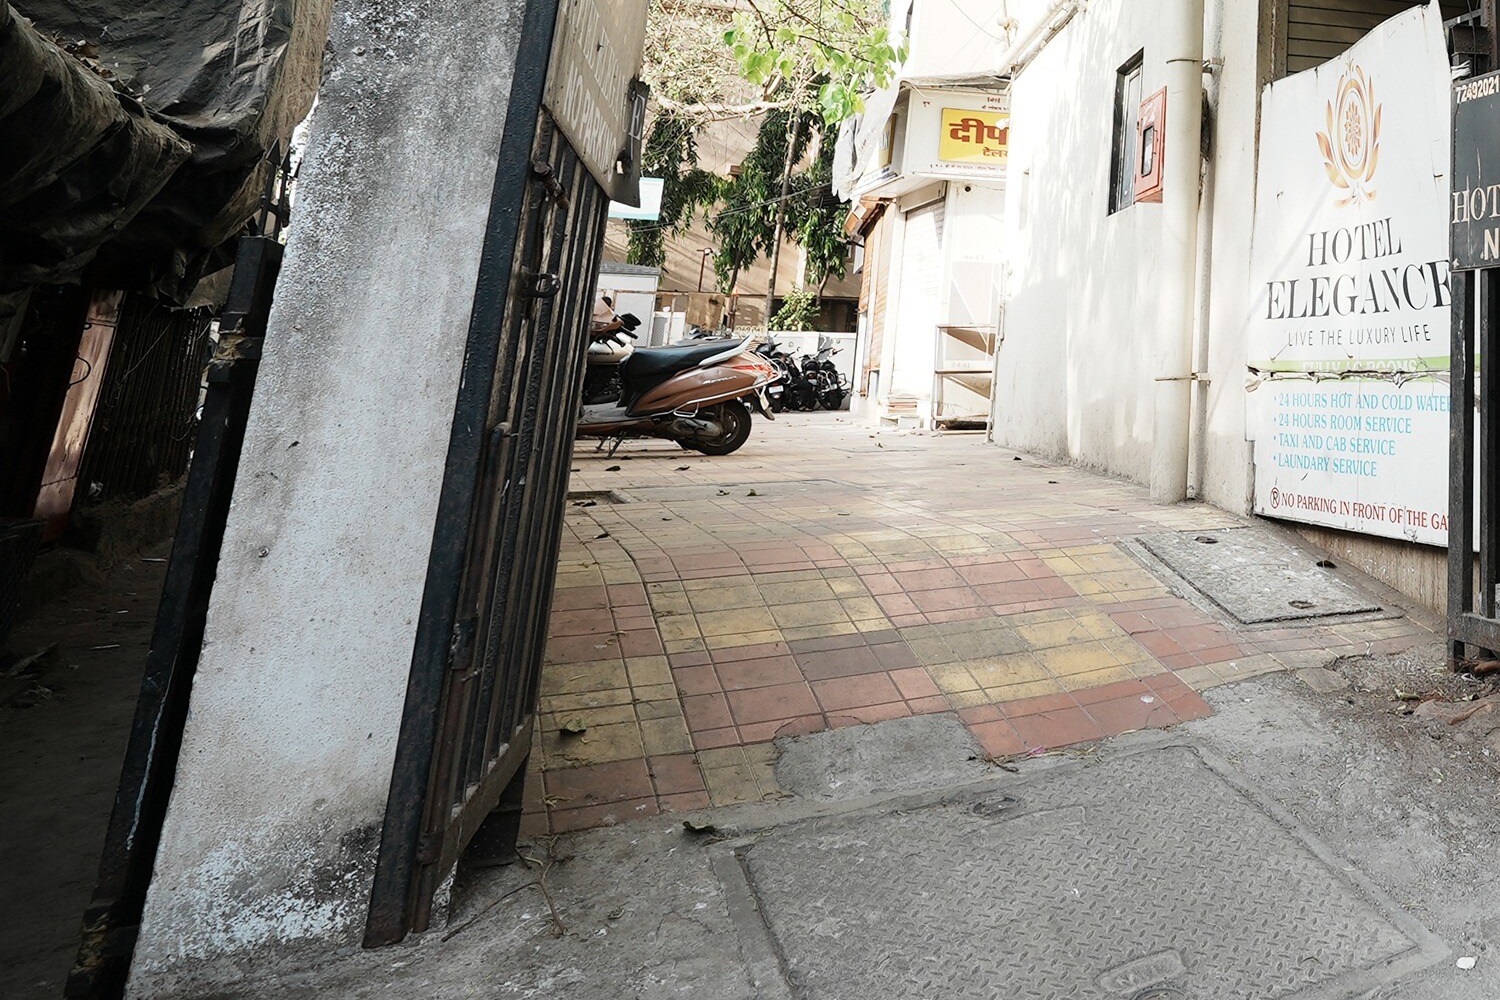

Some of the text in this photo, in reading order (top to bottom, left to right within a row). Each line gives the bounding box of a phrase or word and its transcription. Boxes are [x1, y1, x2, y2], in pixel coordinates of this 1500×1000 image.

[563, 60, 584, 131] NO
[1306, 217, 1402, 268] HOTEL
[1265, 259, 1452, 320] ELEGANCE
[1288, 323, 1431, 347] LIVE THE LUXURY LIFE
[1279, 393, 1451, 412] 24 HOURS HOT AND COLD WATE
[1278, 413, 1412, 434] 24 HOURS ROOM SERVICE
[1278, 432, 1396, 456] TAXI AND CAB SERVICE
[1278, 453, 1378, 477] LAUNDARY SERVICE
[1281, 492, 1294, 507] NO
[1297, 494, 1337, 514] PARKING
[1339, 499, 1350, 516] IN
[1352, 502, 1387, 521] FRONT
[1389, 507, 1403, 523] OF
[1406, 509, 1428, 528] THE
